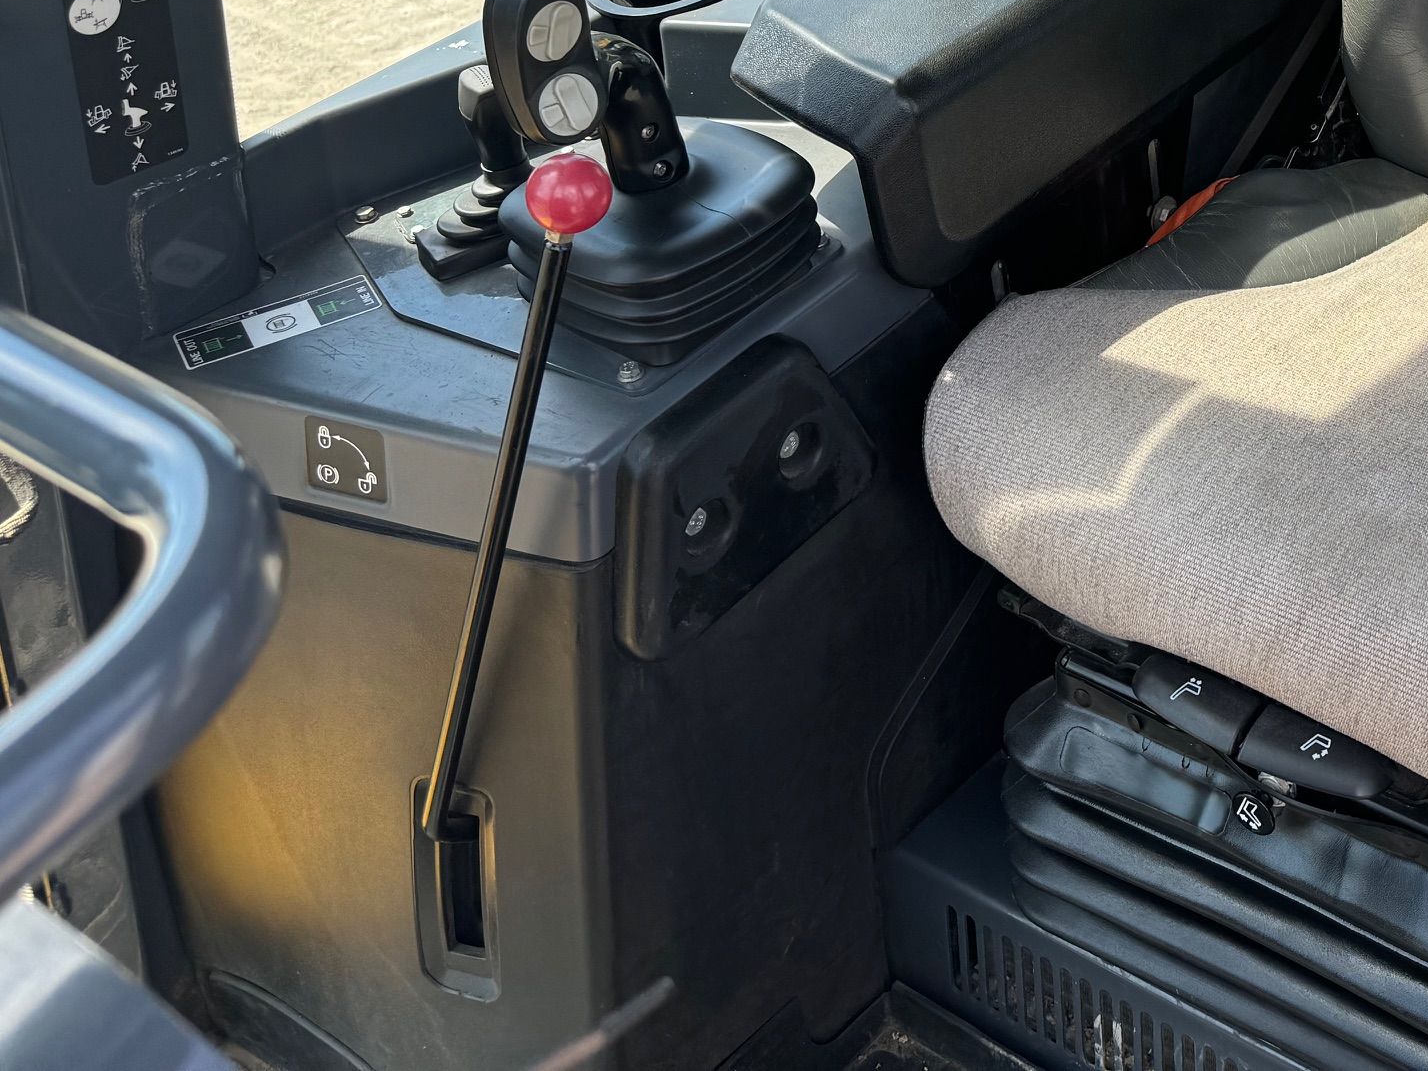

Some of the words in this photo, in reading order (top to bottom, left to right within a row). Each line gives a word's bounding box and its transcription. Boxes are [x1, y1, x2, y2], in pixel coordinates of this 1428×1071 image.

[360, 292, 374, 306] LINE
[183, 338, 196, 353] OUT
[189, 352, 204, 366] LINE
